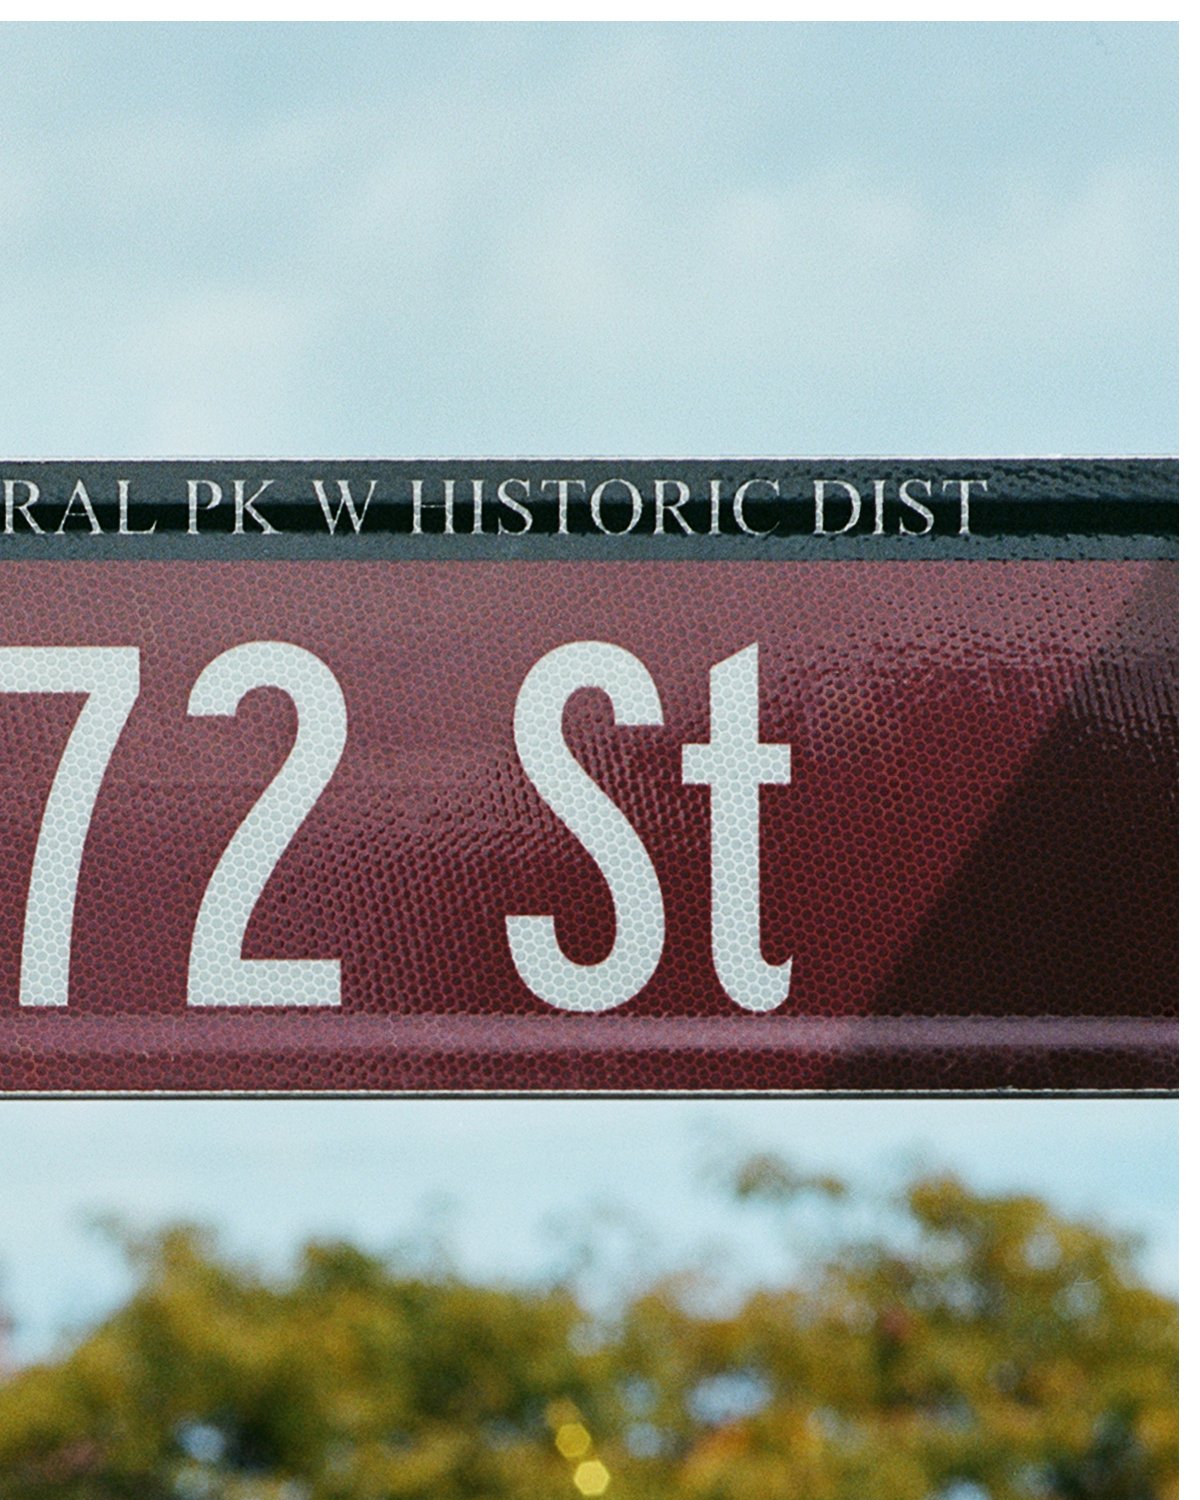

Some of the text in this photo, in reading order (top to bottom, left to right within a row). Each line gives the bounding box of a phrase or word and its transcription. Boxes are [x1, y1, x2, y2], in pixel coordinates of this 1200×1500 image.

[185, 479, 283, 535] PK
[311, 479, 378, 535] W
[410, 478, 781, 535] HISTORIC
[811, 478, 988, 535] DIST
[505, 640, 793, 1012] St
